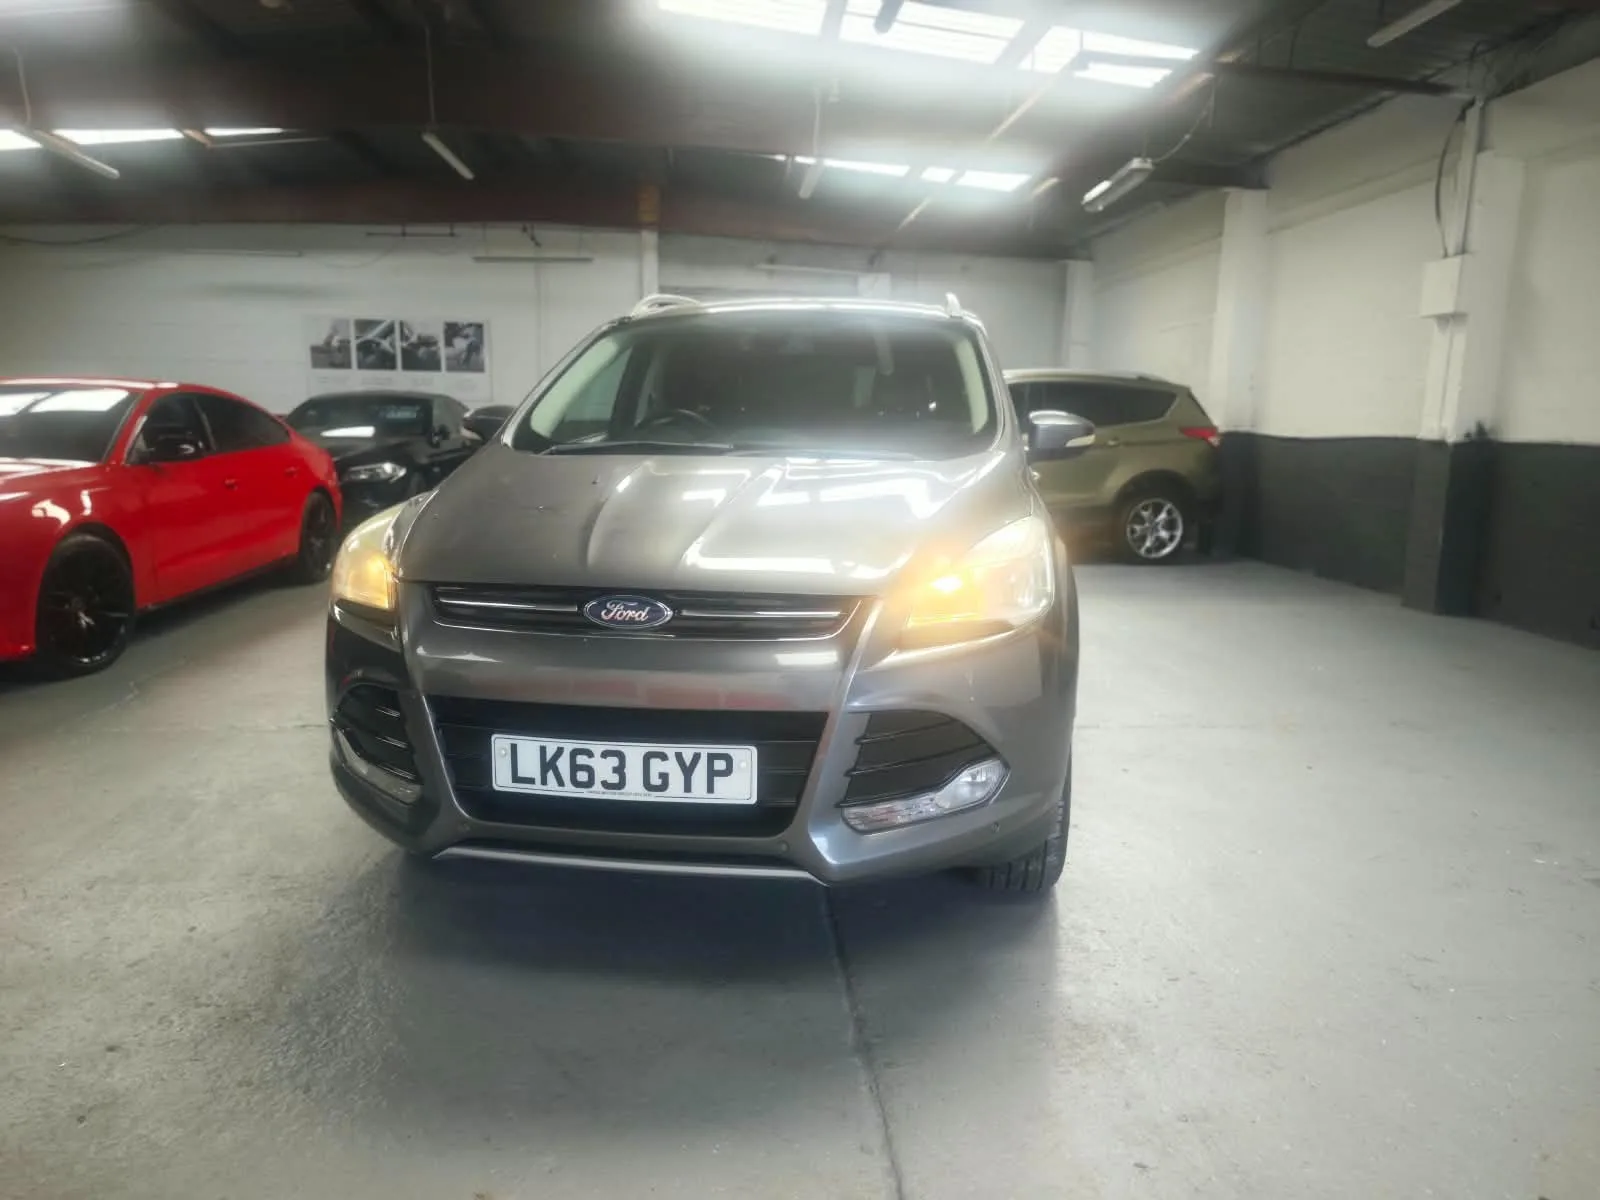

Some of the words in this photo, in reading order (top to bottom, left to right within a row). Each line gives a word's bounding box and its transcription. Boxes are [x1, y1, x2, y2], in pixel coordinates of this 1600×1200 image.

[601, 600, 651, 622] Ford
[509, 742, 627, 791] LK63
[642, 750, 734, 794] GYP
